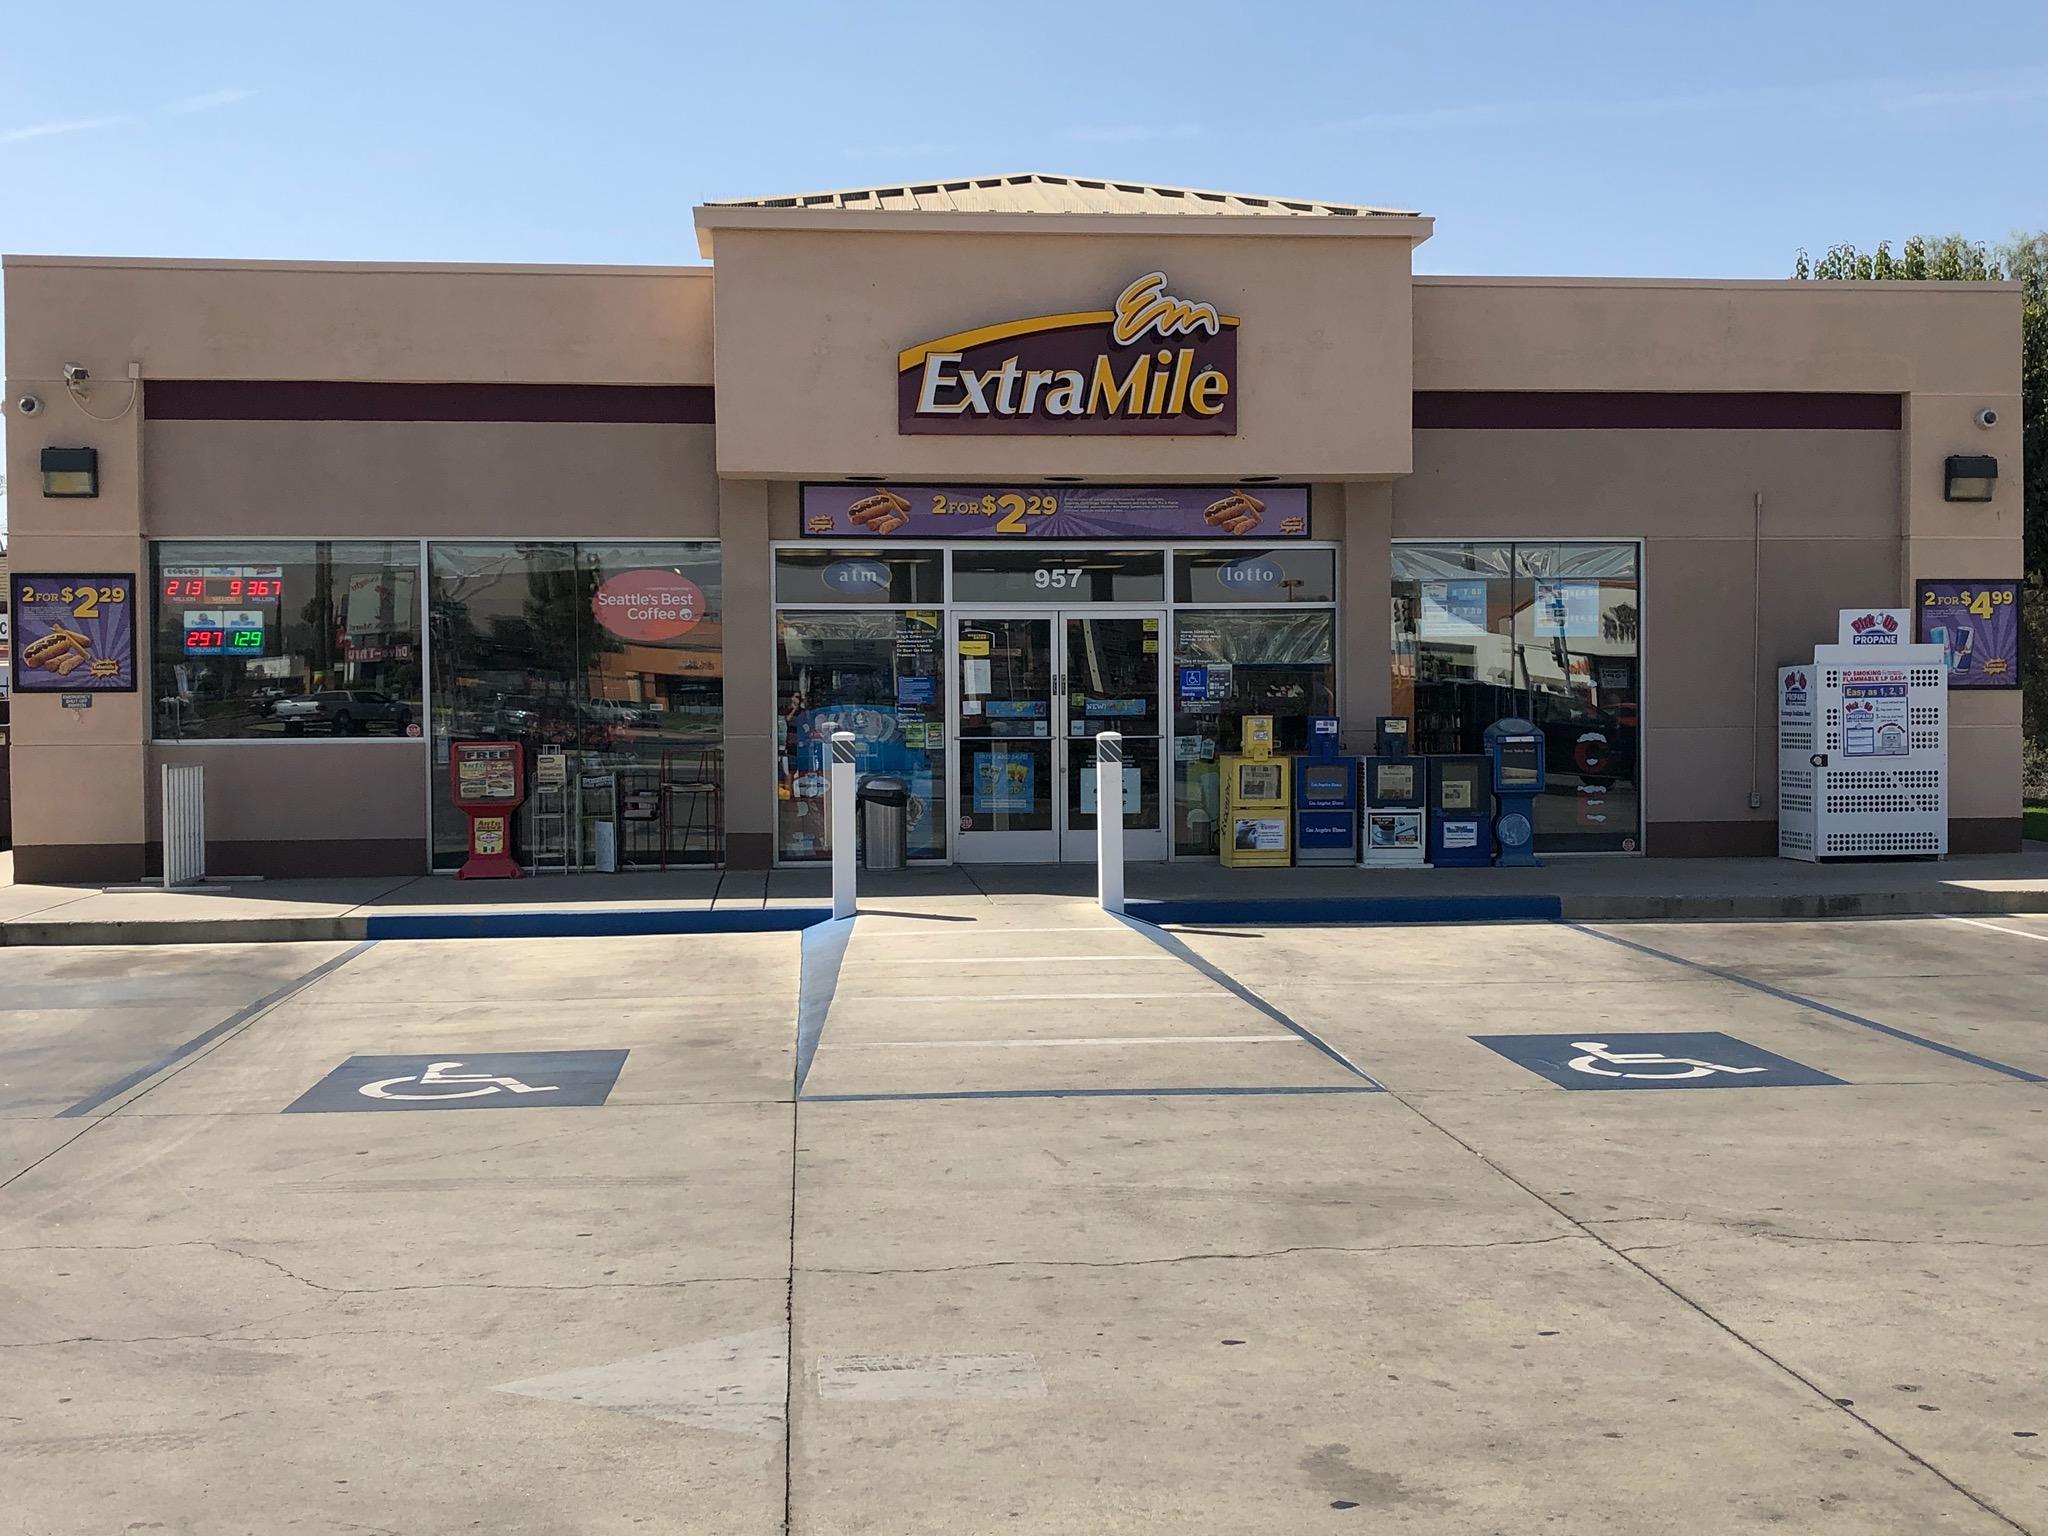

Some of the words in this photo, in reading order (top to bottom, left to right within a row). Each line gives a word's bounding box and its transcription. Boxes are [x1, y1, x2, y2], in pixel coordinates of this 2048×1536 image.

[916, 348, 1229, 415] ExtraMile
[932, 495, 947, 514] 2
[948, 501, 979, 514] FOR
[839, 566, 877, 582] atm
[1034, 568, 1082, 588] 957
[1226, 566, 1273, 582] lotto
[22, 586, 34, 602] 2
[35, 593, 59, 601] FOR
[167, 580, 203, 596] 213
[230, 580, 242, 596] 9
[246, 580, 282, 596] 367
[598, 593, 658, 606] Seattle's
[661, 593, 693, 605] Best
[1924, 591, 1936, 606] 2
[1937, 596, 1959, 605] FOR
[627, 607, 676, 620] Coffee
[187, 631, 223, 646] 297
[234, 631, 262, 646] 129
[1853, 635, 1898, 645] PROPANE
[1847, 688, 1866, 698] Easy
[1899, 687, 1905, 695] 3
[465, 751, 510, 760] FREE
